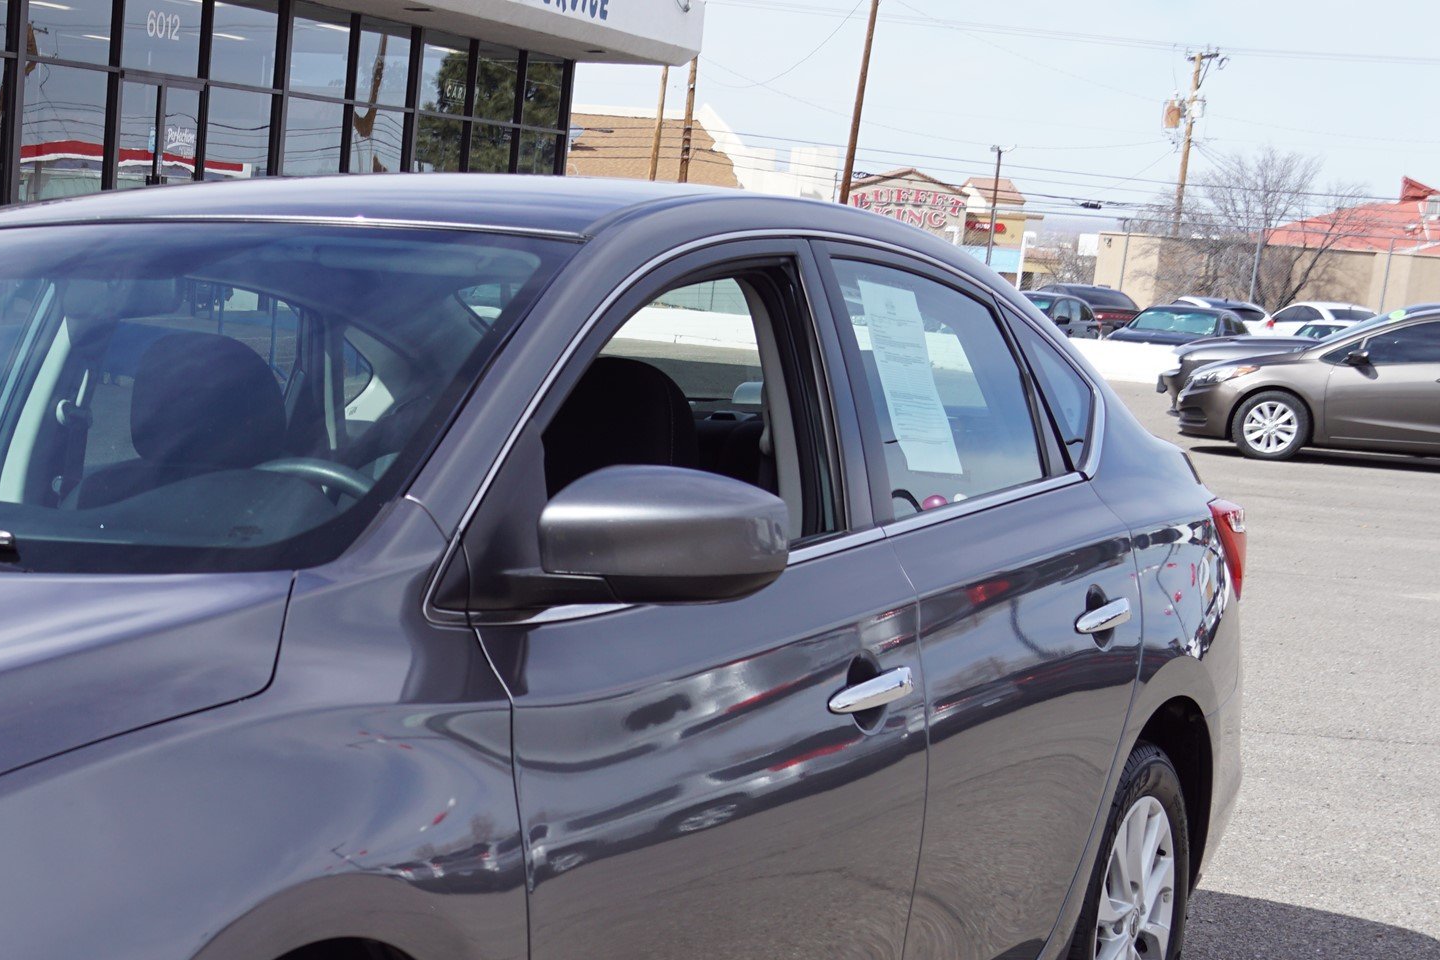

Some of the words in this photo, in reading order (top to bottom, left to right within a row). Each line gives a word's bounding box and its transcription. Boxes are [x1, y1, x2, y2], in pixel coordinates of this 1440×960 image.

[147, 10, 180, 40] 6012
[167, 126, 195, 144] Perfection
[852, 188, 966, 217] BUFFET
